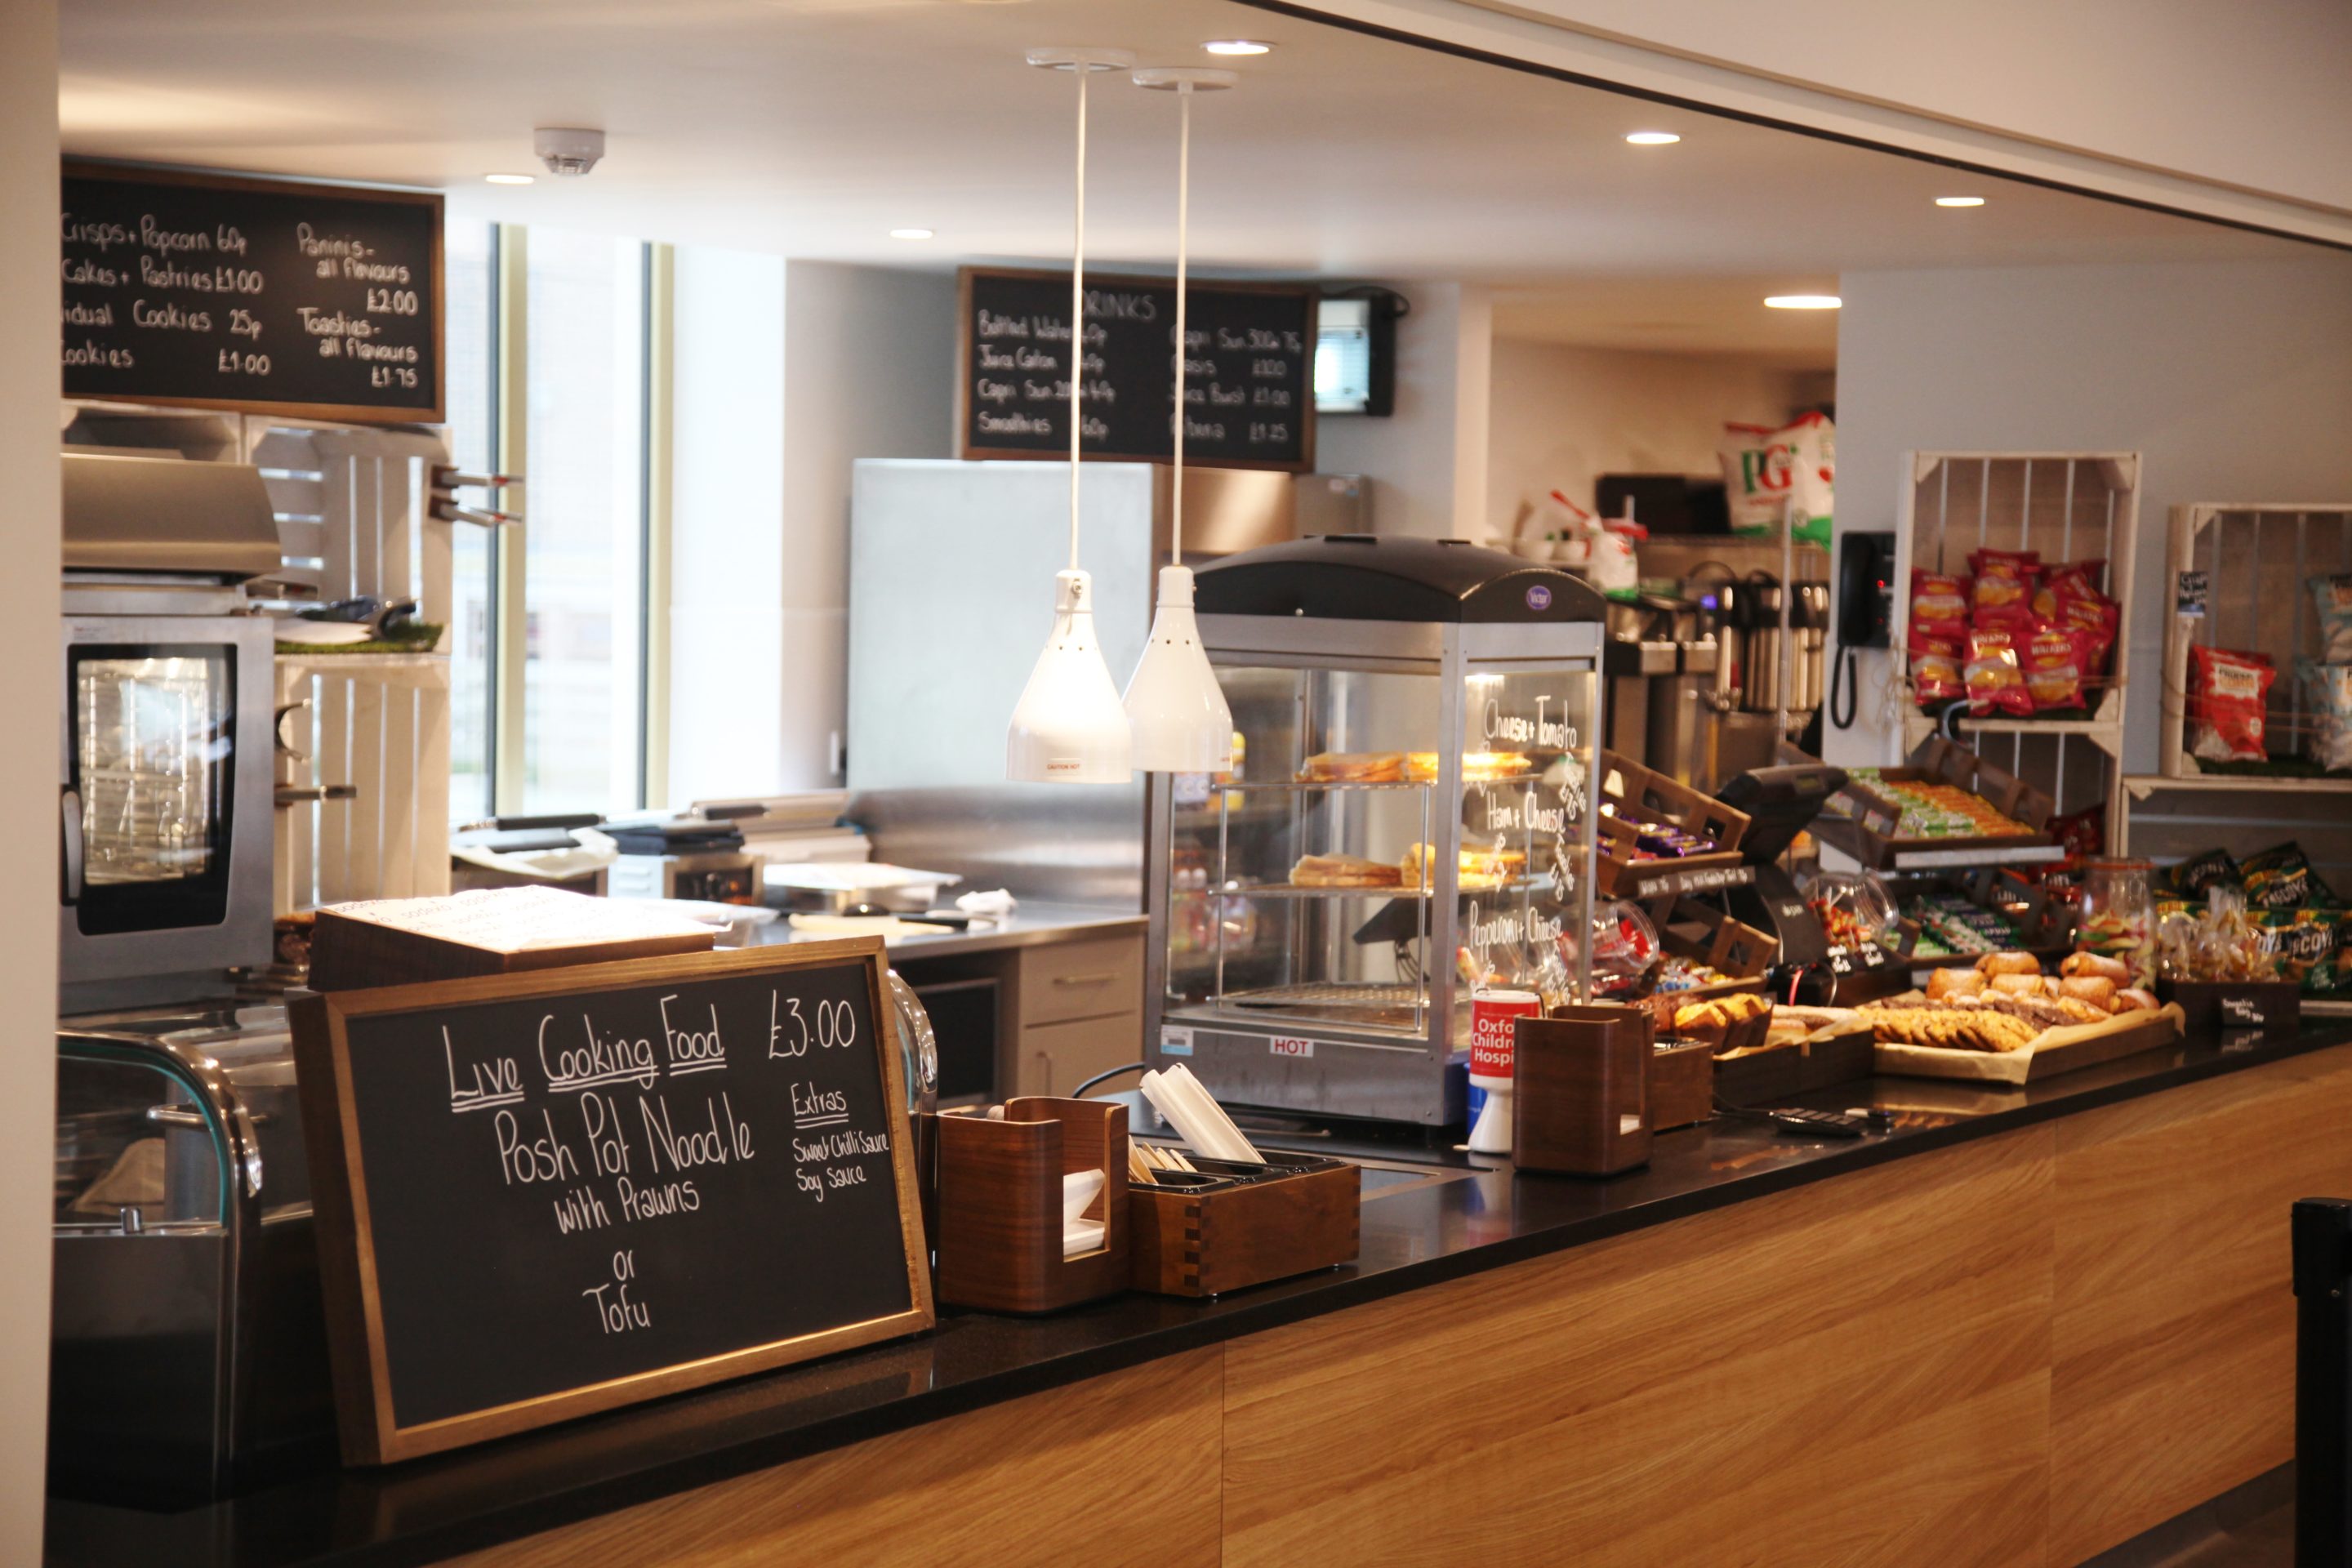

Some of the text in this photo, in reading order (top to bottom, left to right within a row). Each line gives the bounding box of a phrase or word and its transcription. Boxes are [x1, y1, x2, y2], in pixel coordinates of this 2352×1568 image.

[61, 213, 126, 252] Crisps
[140, 214, 211, 257] Popcorn
[217, 224, 248, 256] 60p
[61, 259, 117, 286] Cakes
[140, 255, 213, 292] Pastries
[316, 256, 411, 285] all flavours
[60, 299, 263, 341] idual Cookies 25p
[1080, 291, 1156, 321] RINKS
[319, 336, 419, 364] all flavours
[1484, 698, 1527, 742] Cheese
[1535, 696, 1577, 749] Tomato
[1486, 790, 1512, 831] Ham
[1524, 790, 1566, 834] Cheese
[1470, 900, 1518, 962] Pepperoni
[1527, 906, 1563, 943] Cheese
[768, 990, 857, 1058] £3.00
[1472, 1031, 1514, 1049] Childr
[1477, 1018, 1514, 1035] Oxfo
[443, 995, 725, 1099] Live Cooking Food
[1274, 1039, 1309, 1055] HOT
[1474, 1048, 1514, 1067] Hospi
[791, 1080, 848, 1116] Extras
[494, 1092, 755, 1185] Posh Pot Noodle
[792, 1130, 890, 1163] Sweet Chilli Sauce
[795, 1165, 867, 1203] Soy Sauce
[555, 1176, 700, 1234] with Prawns
[614, 1250, 635, 1281] or
[582, 1285, 651, 1334] Tofu
